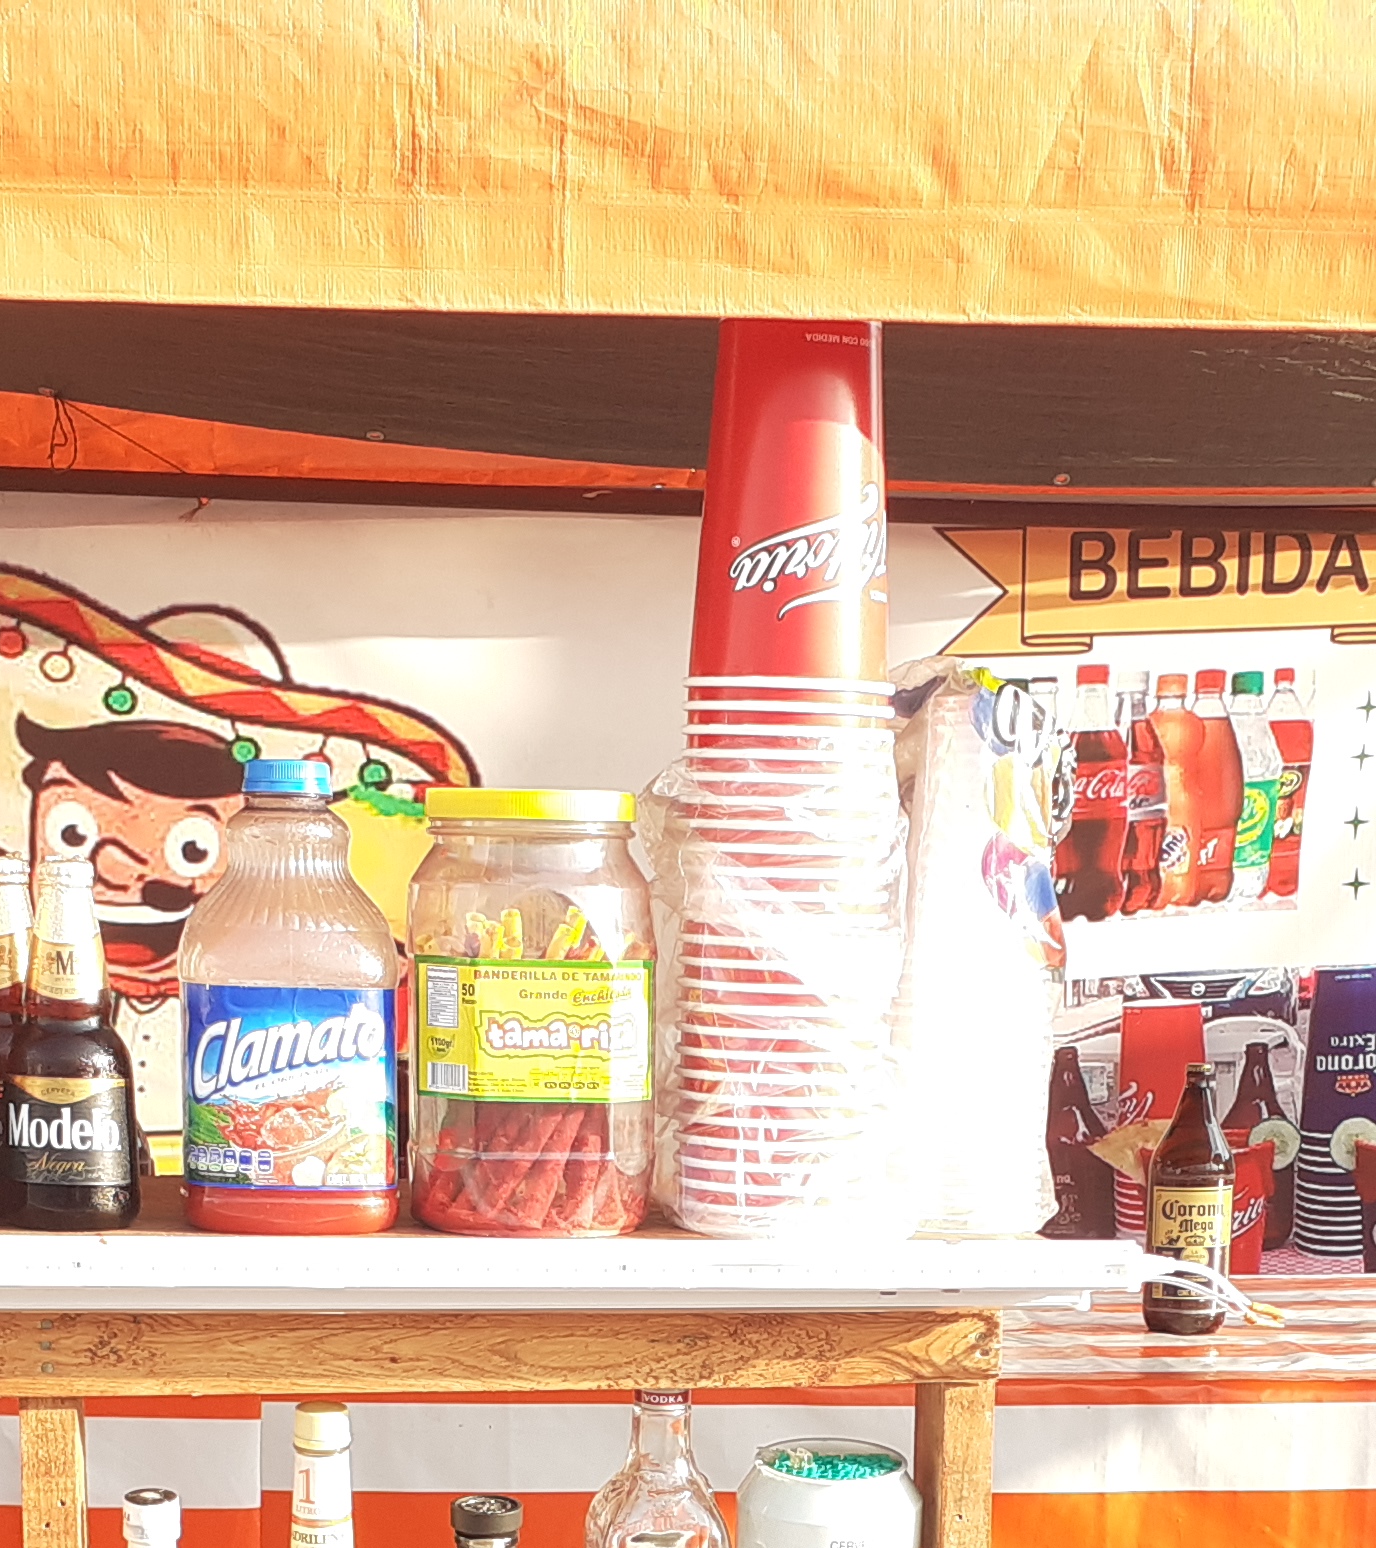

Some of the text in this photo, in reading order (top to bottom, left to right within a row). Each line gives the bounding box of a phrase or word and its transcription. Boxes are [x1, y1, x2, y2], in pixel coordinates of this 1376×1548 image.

[1067, 529, 1370, 602] BEBIDA
[191, 1001, 386, 1105] Clamato
[8, 1102, 122, 1151] Modelo
[29, 1151, 87, 1173] Negra
[642, 1393, 684, 1404] VODKA
[297, 1467, 316, 1505] 1
